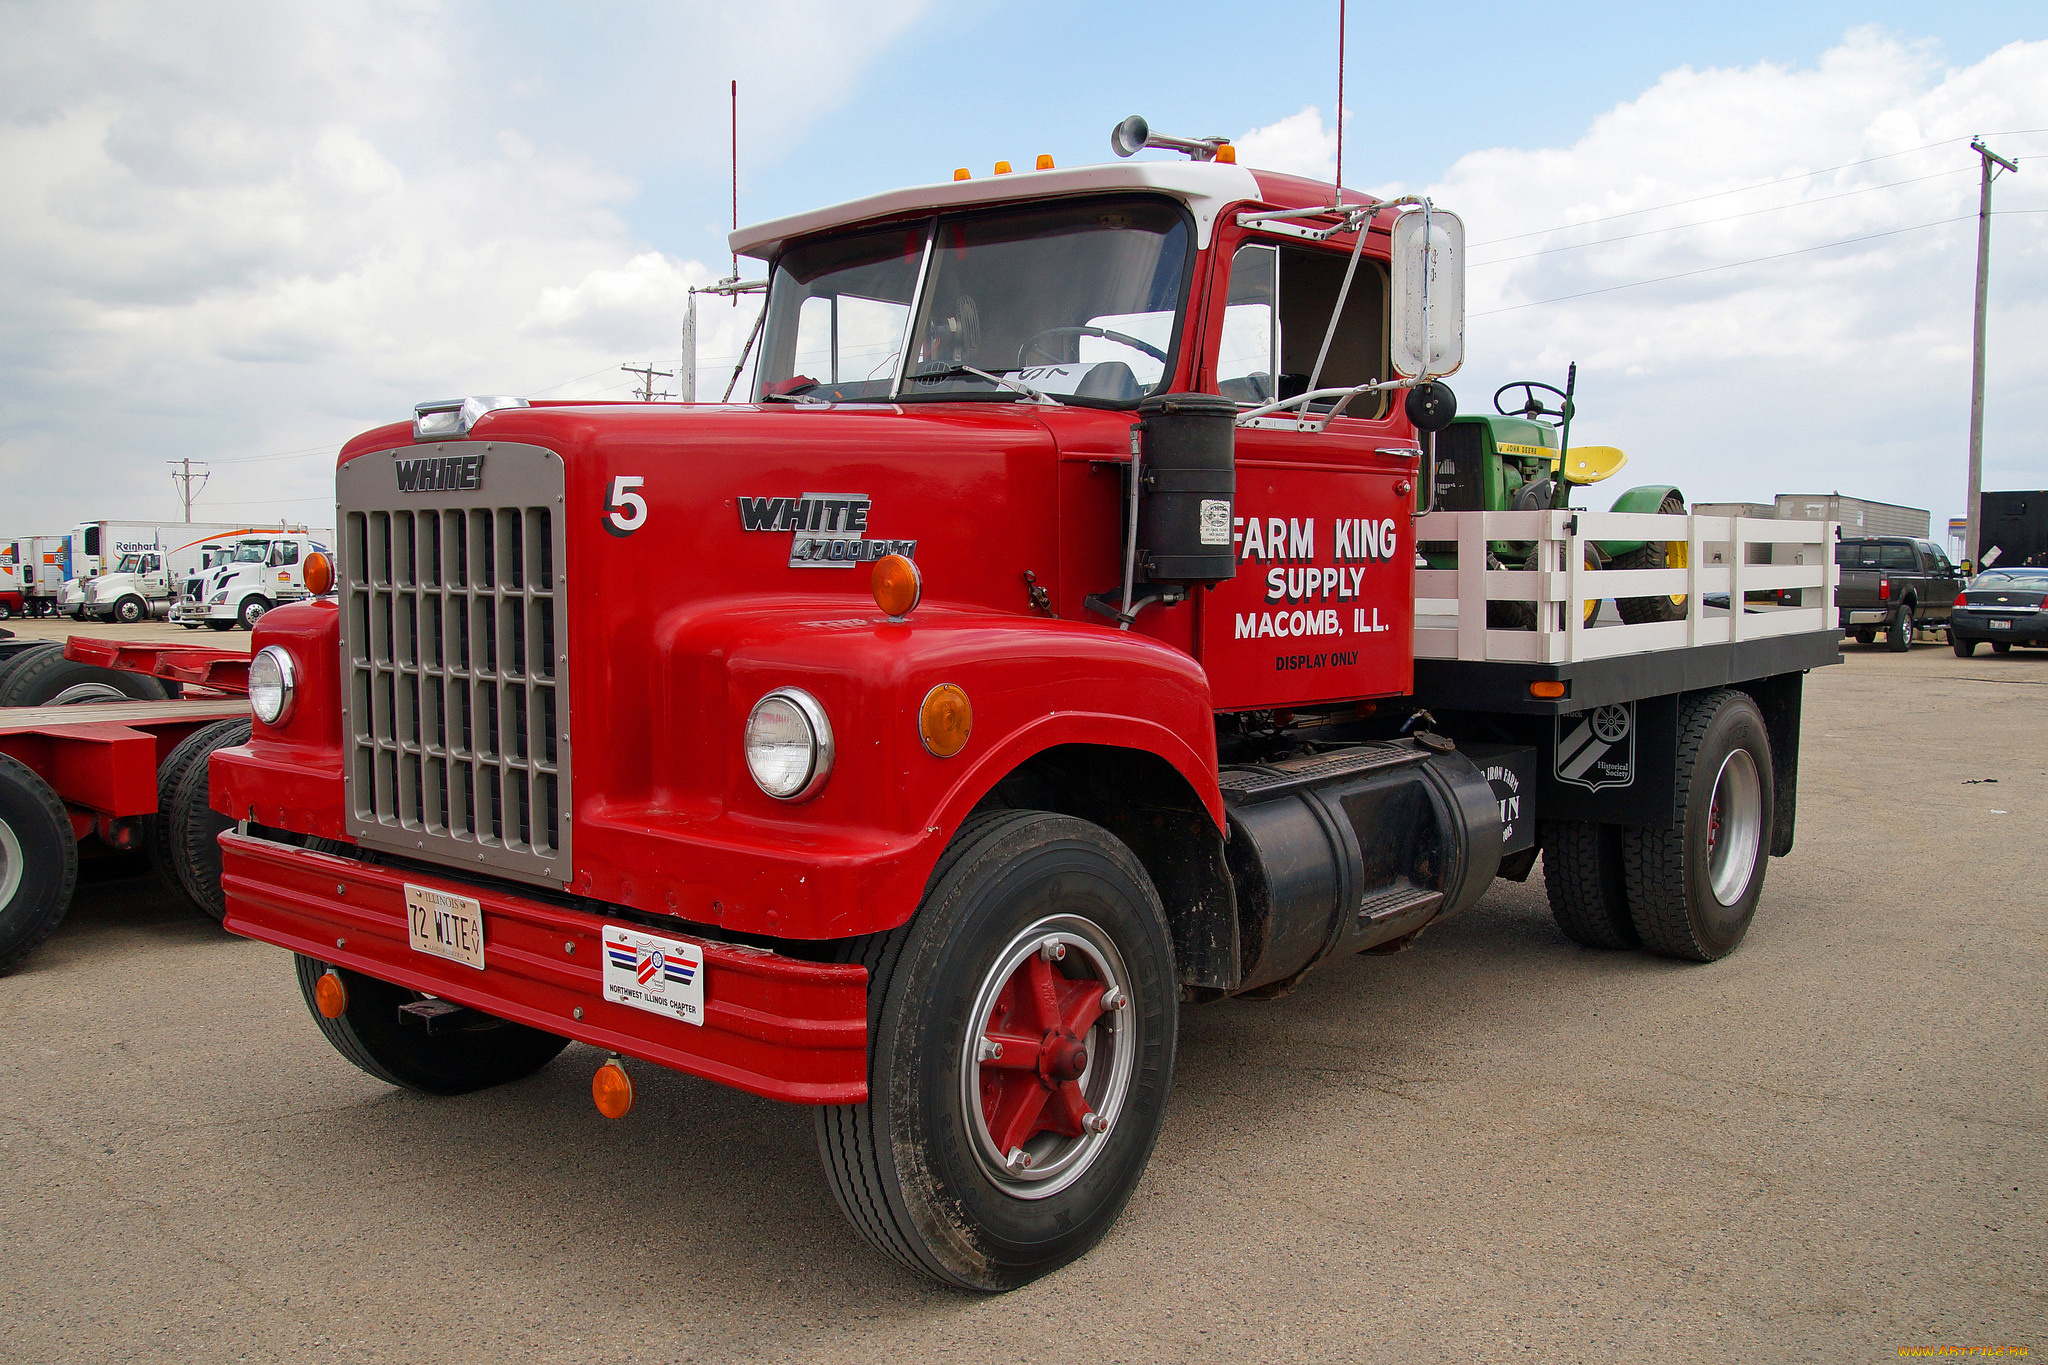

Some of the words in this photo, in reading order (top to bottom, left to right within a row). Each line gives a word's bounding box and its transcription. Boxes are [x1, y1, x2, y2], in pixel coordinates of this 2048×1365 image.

[1507, 444, 1520, 453] JOHN
[1522, 446, 1537, 455] DEERE
[395, 455, 484, 492] WHITE
[606, 476, 647, 535] 5
[737, 496, 872, 532] WHITE
[792, 540, 864, 561] 4700
[1335, 518, 1397, 560] KING
[1265, 567, 1366, 600] SUPPLY
[1235, 609, 1343, 640] MACOMB,
[1354, 608, 1389, 633] ILL.
[1276, 653, 1328, 671] DISPLAY
[1331, 651, 1359, 667] ONLY
[1487, 766, 1504, 781] IRON
[1503, 768, 1519, 793] FARM
[1597, 761, 1629, 771] Historical
[1605, 769, 1629, 780] Society
[1497, 795, 1520, 823] IN
[425, 892, 459, 910] ILLINOIS
[409, 904, 429, 940] 72
[434, 909, 471, 951] WITE
[610, 984, 643, 1000] NORTHWEST
[644, 993, 668, 1007] ILLINOIS
[669, 1000, 697, 1014] CHAPTER
